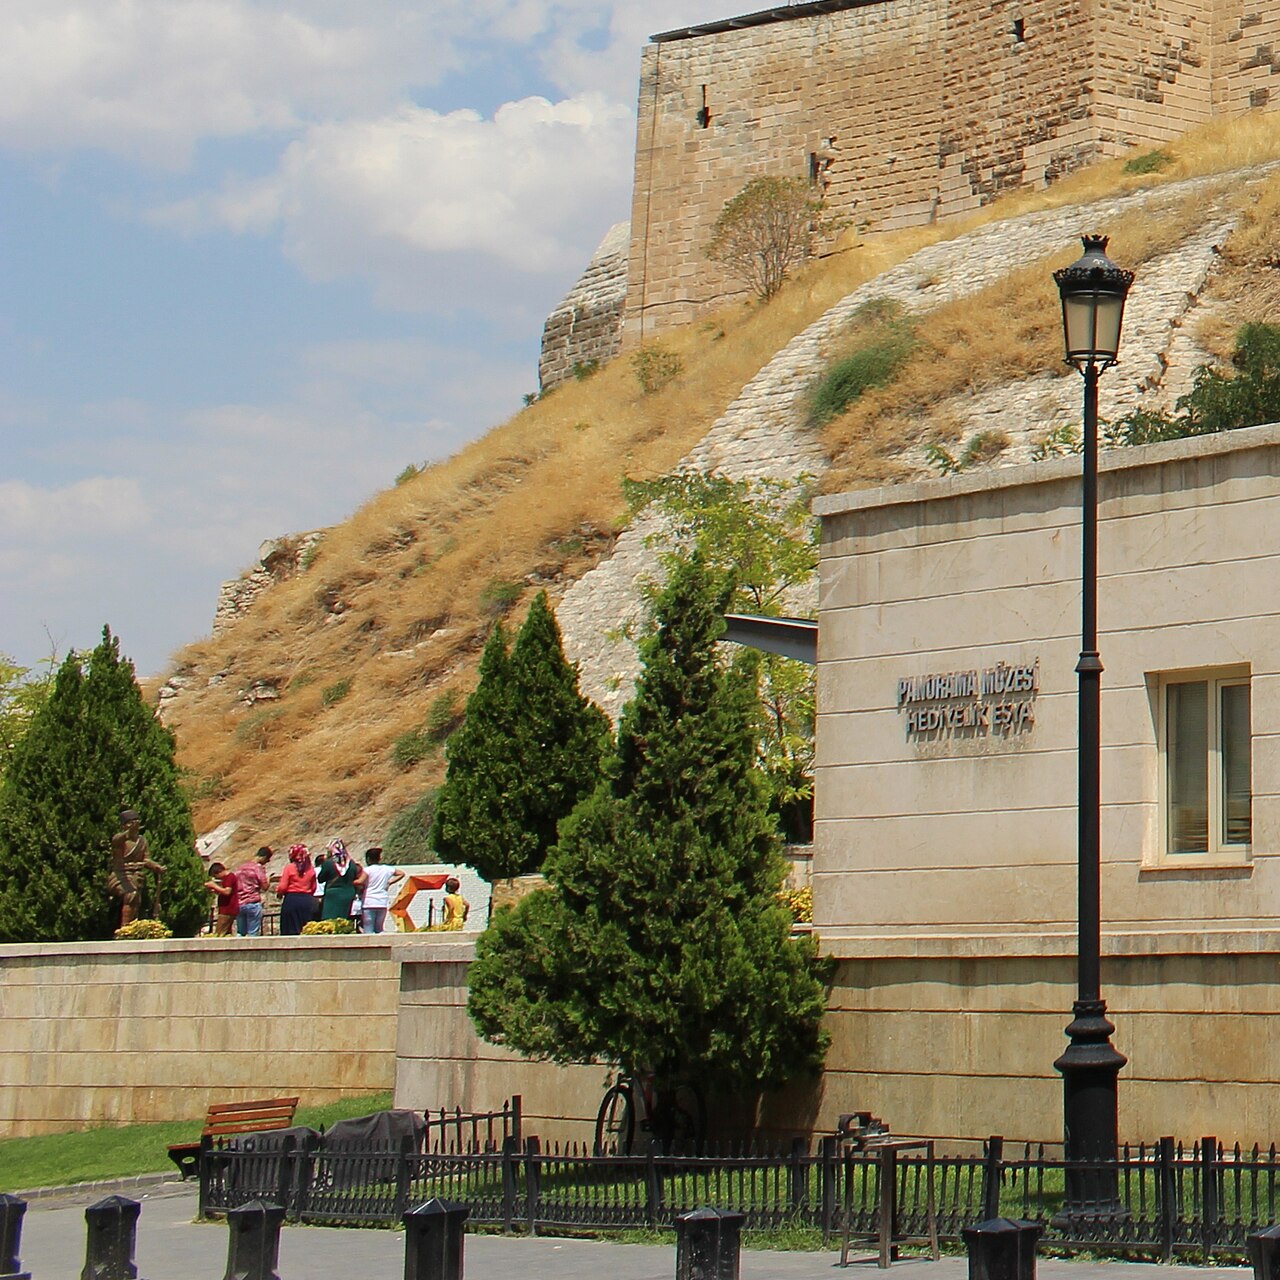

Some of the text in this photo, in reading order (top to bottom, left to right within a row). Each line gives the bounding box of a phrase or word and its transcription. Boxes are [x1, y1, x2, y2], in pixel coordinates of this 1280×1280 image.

[897, 656, 1040, 704] PANORAMA MÜZESİ
[906, 699, 1036, 733] HEDİYELİK EŞYA
